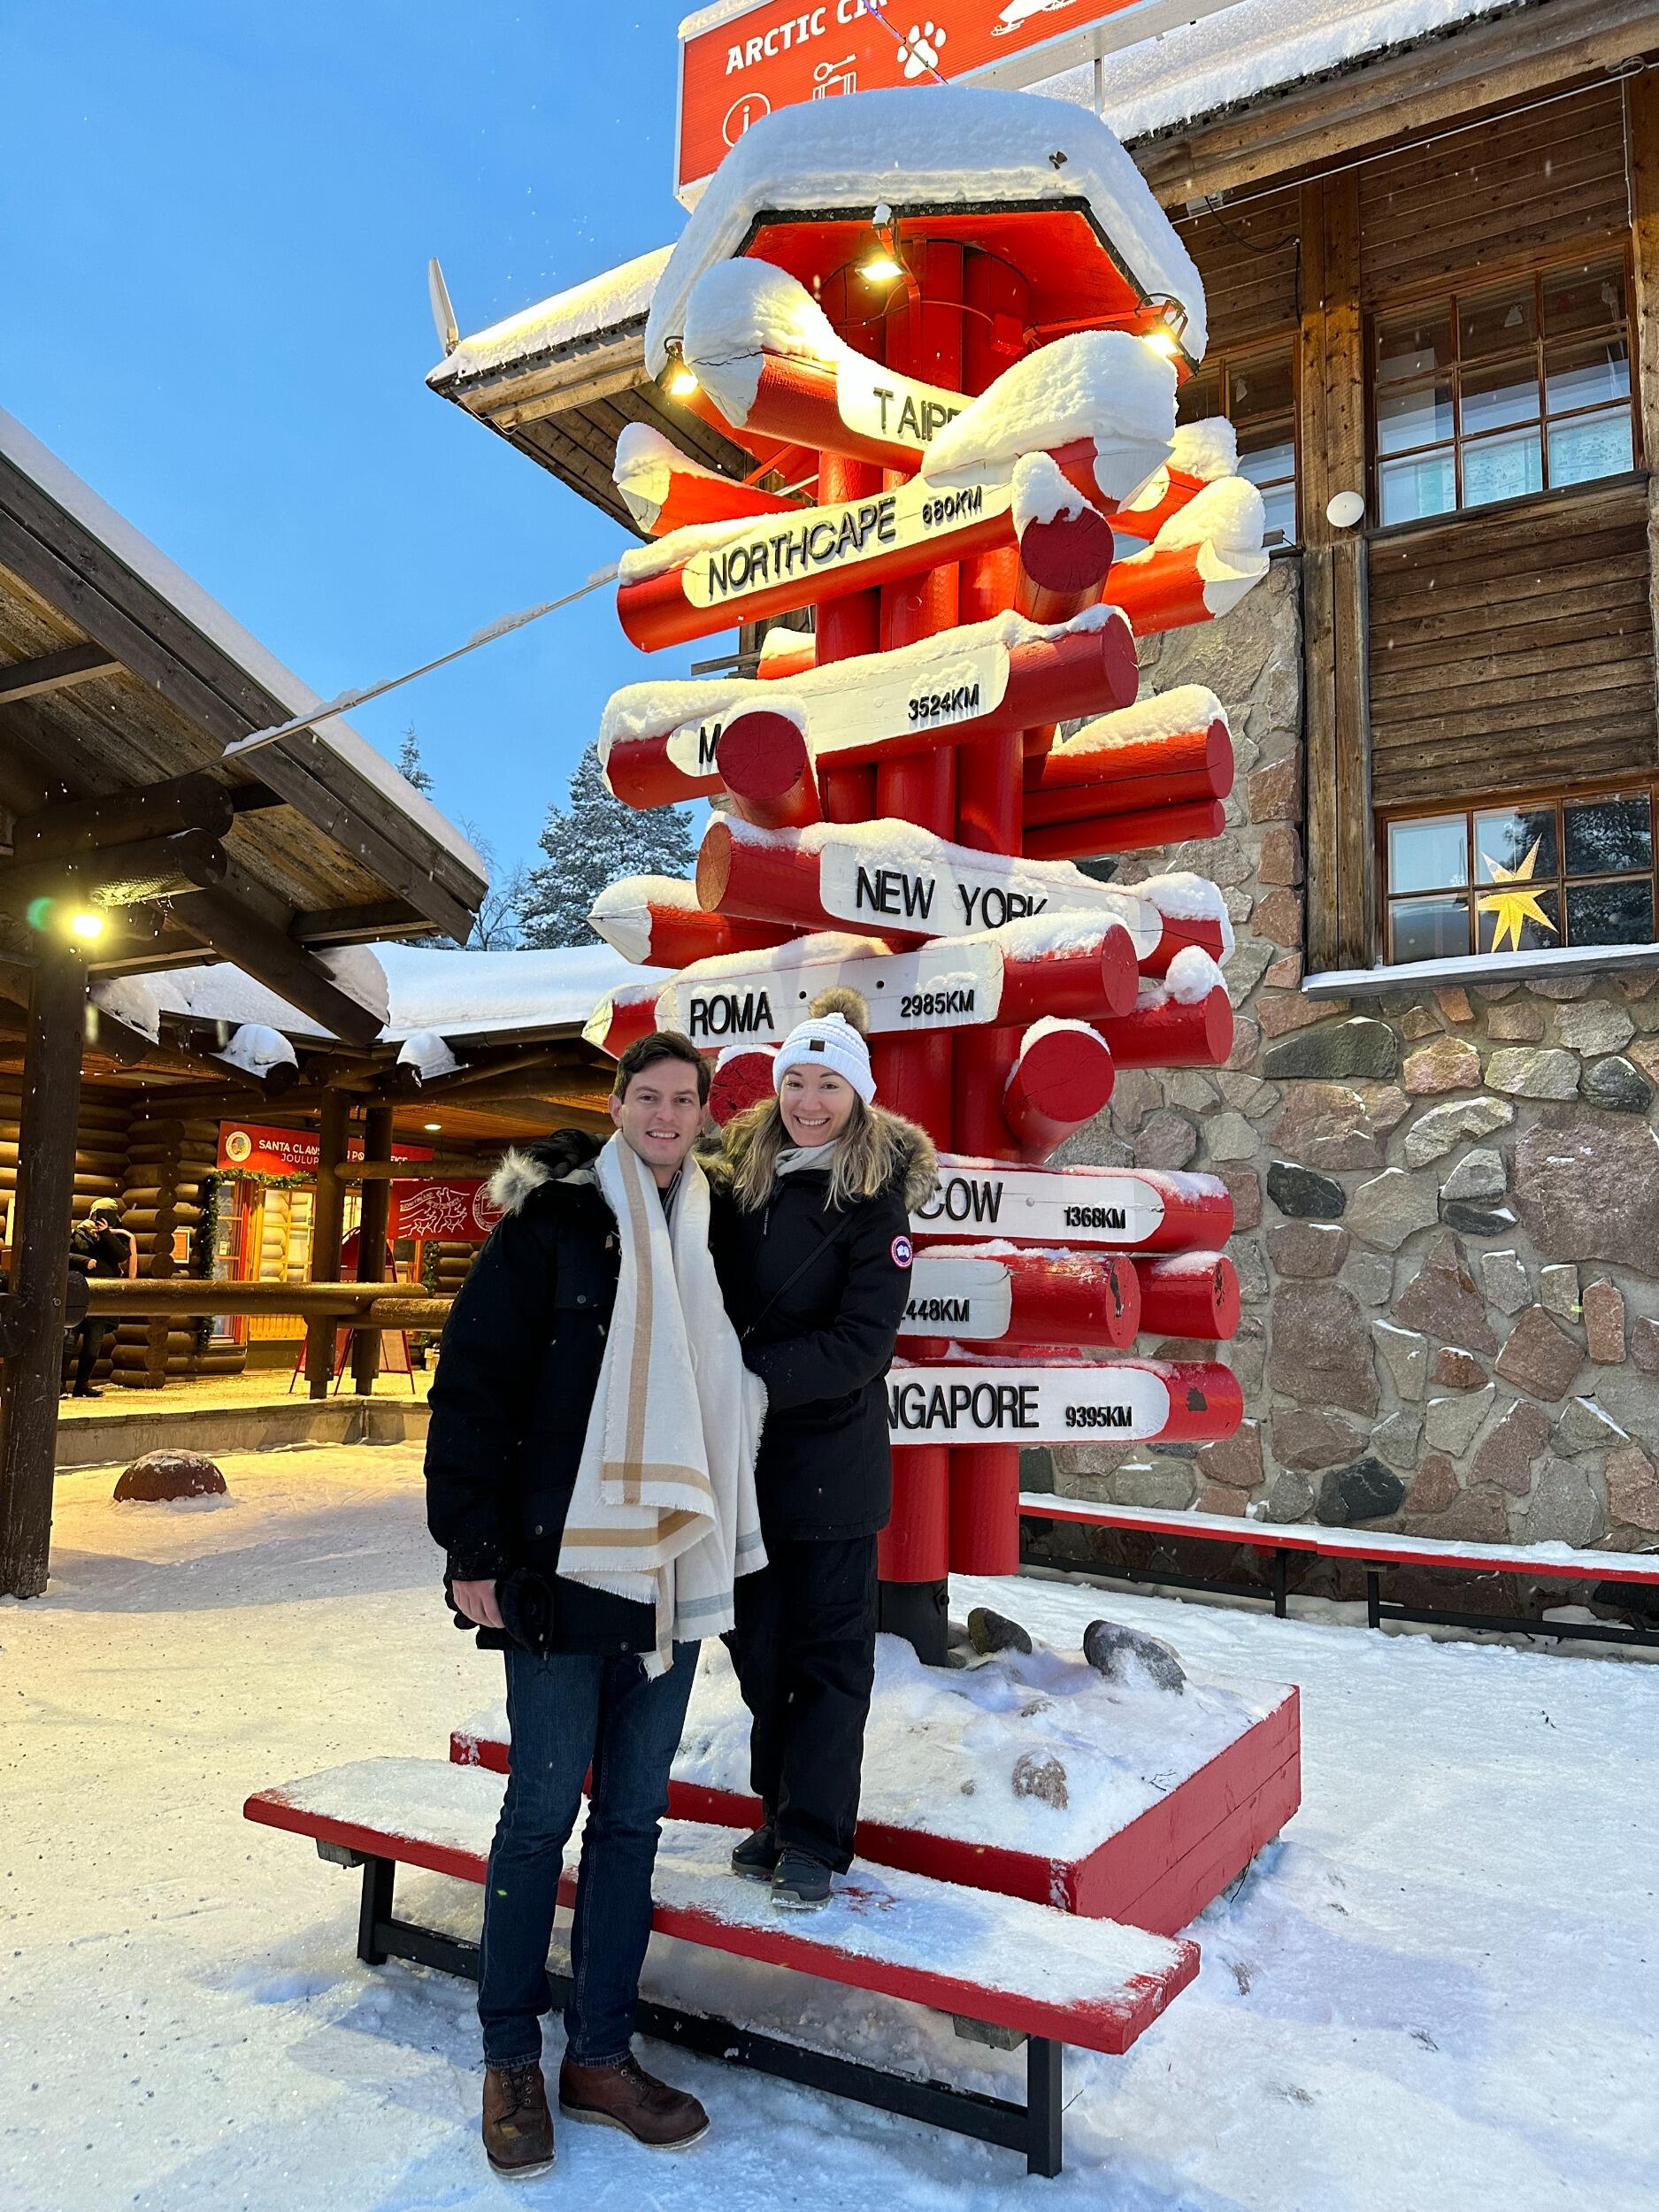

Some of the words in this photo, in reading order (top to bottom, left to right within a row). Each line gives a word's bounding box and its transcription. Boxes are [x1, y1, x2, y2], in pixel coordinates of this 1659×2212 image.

[725, 6, 827, 75] ARCTIC
[708, 495, 897, 595] NORTHCAPE
[922, 485, 982, 525] 680KM
[908, 683, 979, 721] 3524KM
[856, 866, 936, 919] NEW
[689, 991, 775, 1037] ROMA
[901, 989, 975, 1018] 2985KM
[258, 1139, 291, 1153] SANTA
[1064, 1206, 1126, 1230] 1368KM
[901, 1298, 971, 1322] 448KM
[1065, 1405, 1133, 1428] 9395KM
